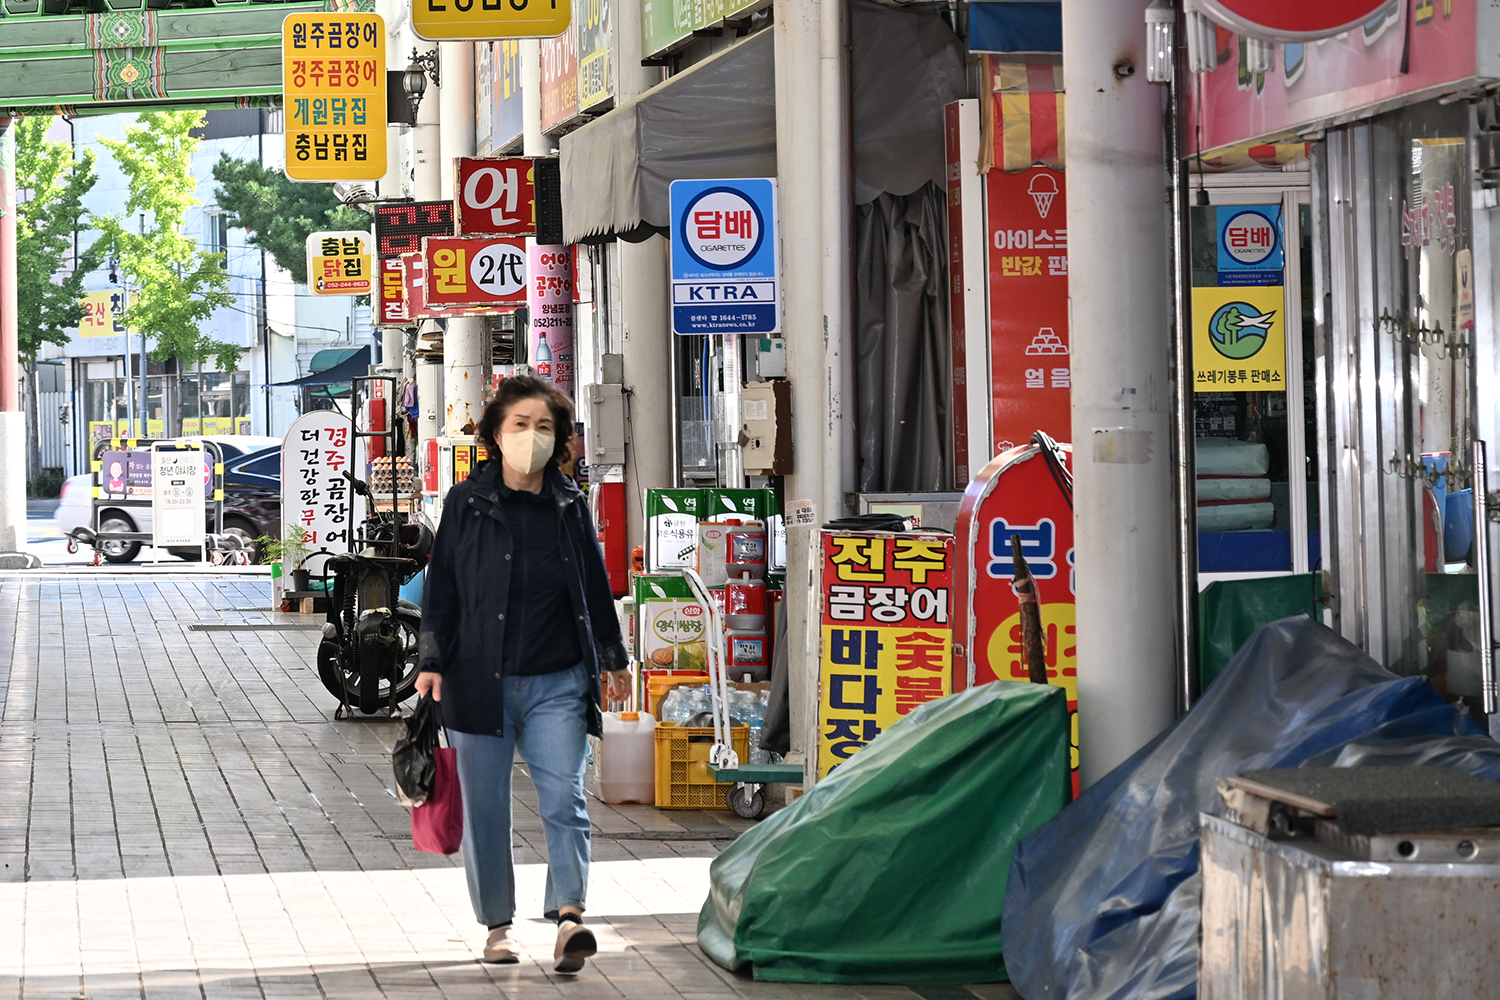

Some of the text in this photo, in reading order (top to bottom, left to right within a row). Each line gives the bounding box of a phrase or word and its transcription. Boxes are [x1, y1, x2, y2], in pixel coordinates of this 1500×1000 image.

[292, 22, 378, 49] 원주곰장어
[292, 60, 378, 88] 경주곰장어
[294, 97, 368, 126] 계원닭집
[295, 133, 368, 161] 충남닭집
[694, 210, 752, 239] 담배
[321, 236, 361, 256] 충남
[1229, 227, 1270, 247] 담배
[700, 244, 746, 252] CIGARETTES
[323, 258, 362, 278] 닭집
[540, 251, 570, 271] 언양
[1002, 256, 1043, 277] 반값
[689, 285, 758, 300] KTRA
[542, 303, 570, 314] 양념포장
[1196, 369, 1282, 384] 쓰레기봉투 판매소
[323, 427, 349, 545] 경주곰장어
[831, 537, 946, 585] 전주
[829, 585, 948, 624] 곰장어
